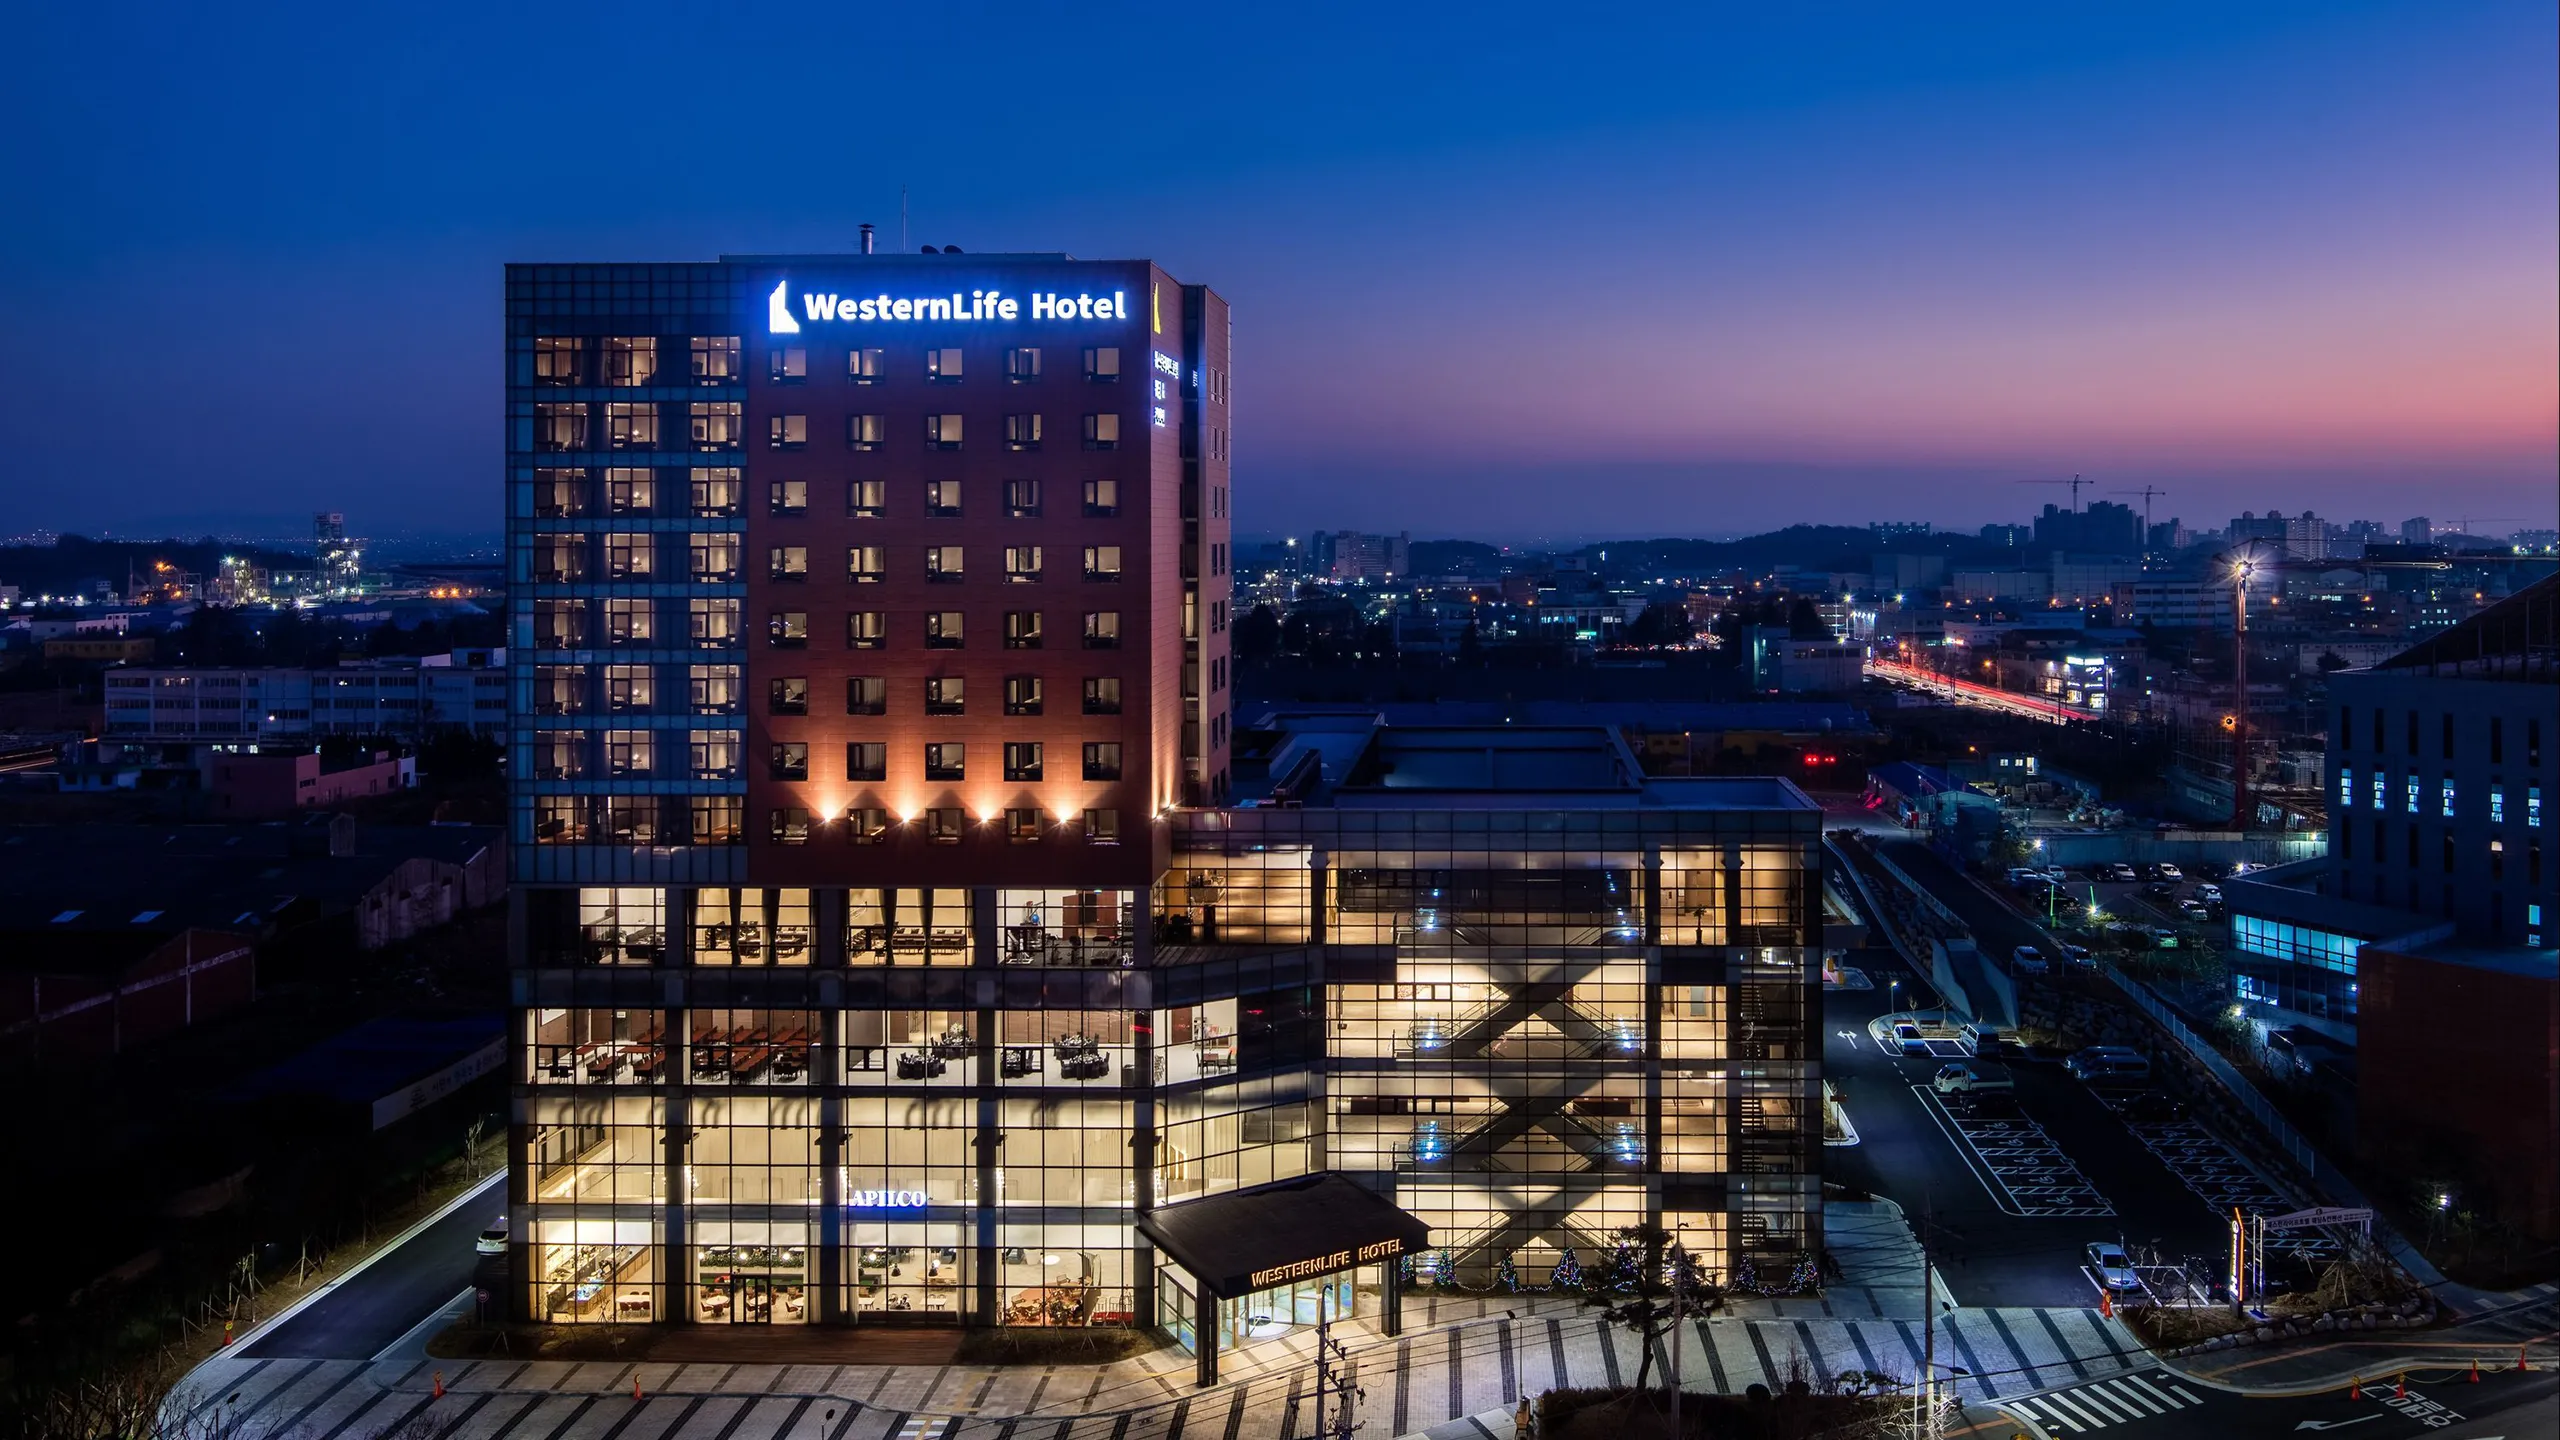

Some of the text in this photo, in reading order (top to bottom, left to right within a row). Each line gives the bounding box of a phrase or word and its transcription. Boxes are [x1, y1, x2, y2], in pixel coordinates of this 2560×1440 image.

[803, 290, 1126, 321] WesternLife Hotel
[848, 1190, 927, 1208] APILCO
[1251, 1238, 1405, 1288] WESTERNLIFE HOTEL
